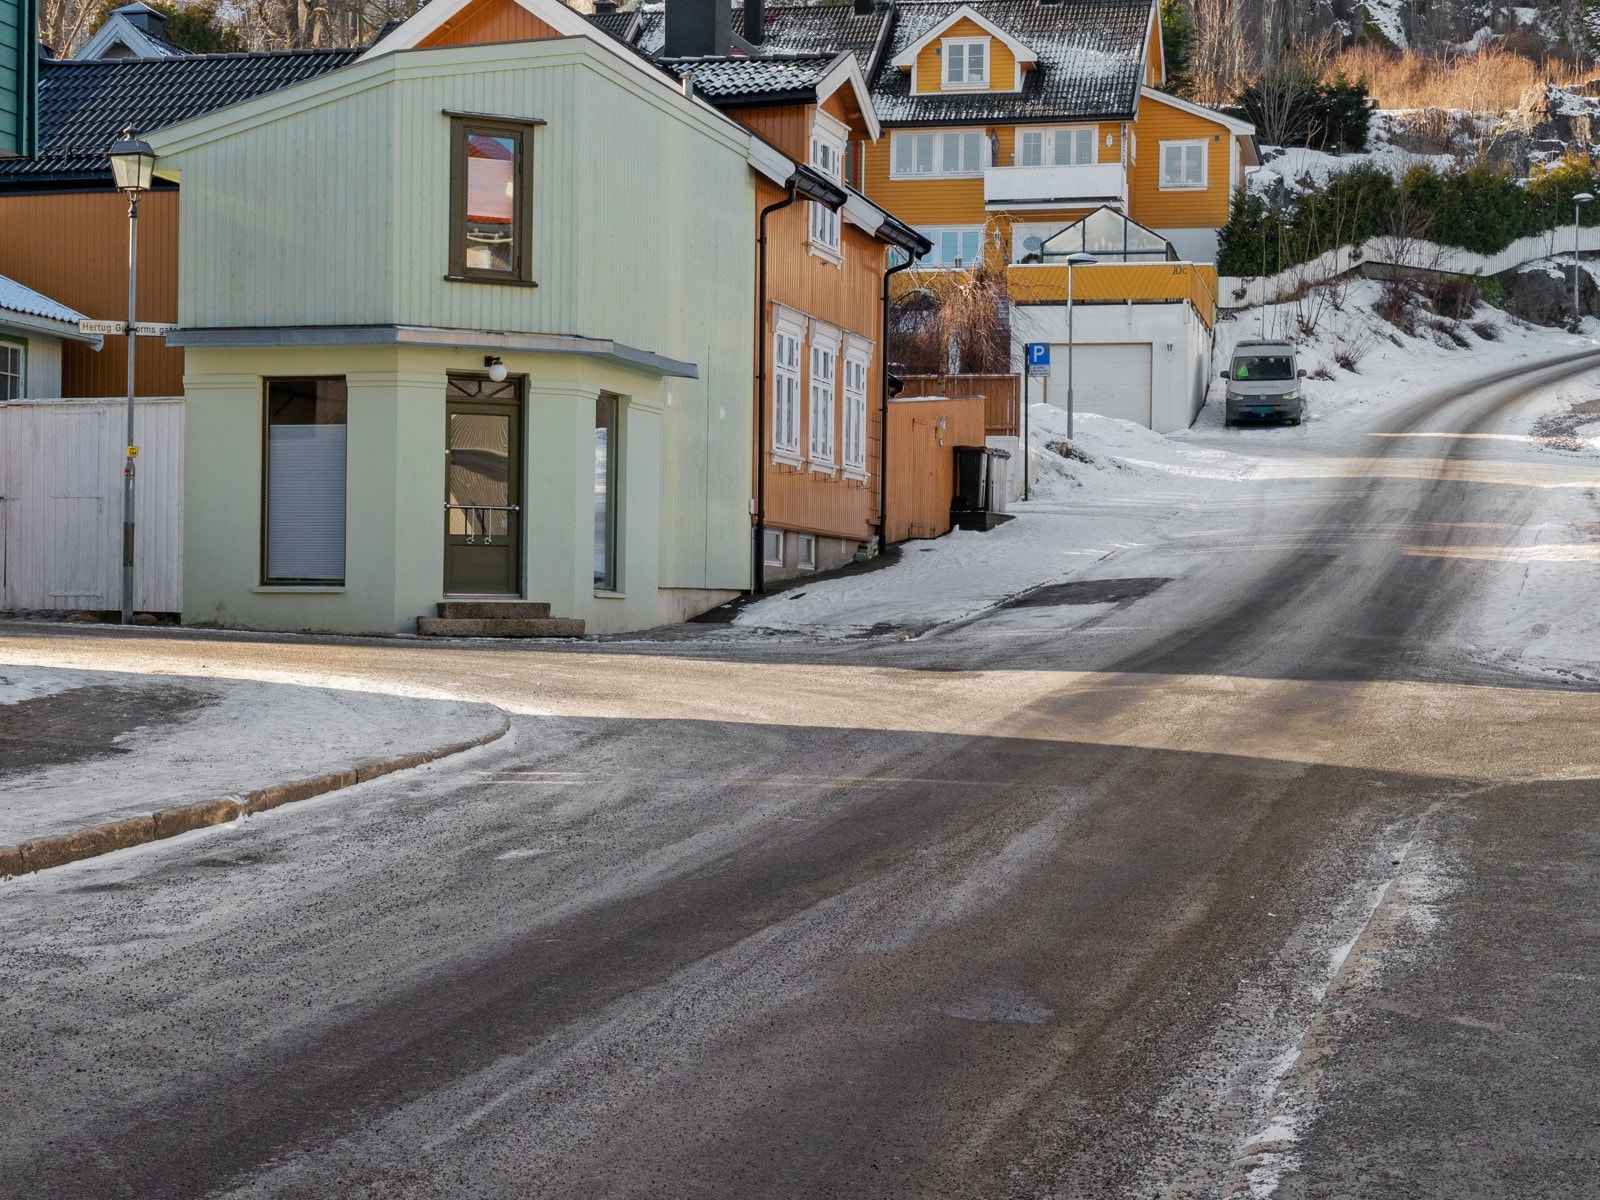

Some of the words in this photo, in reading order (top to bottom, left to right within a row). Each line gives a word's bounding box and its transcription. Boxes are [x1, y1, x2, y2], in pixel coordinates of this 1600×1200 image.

[82, 323, 111, 333] Hertug
[115, 324, 156, 333] Guorms
[1033, 345, 1044, 363] P
